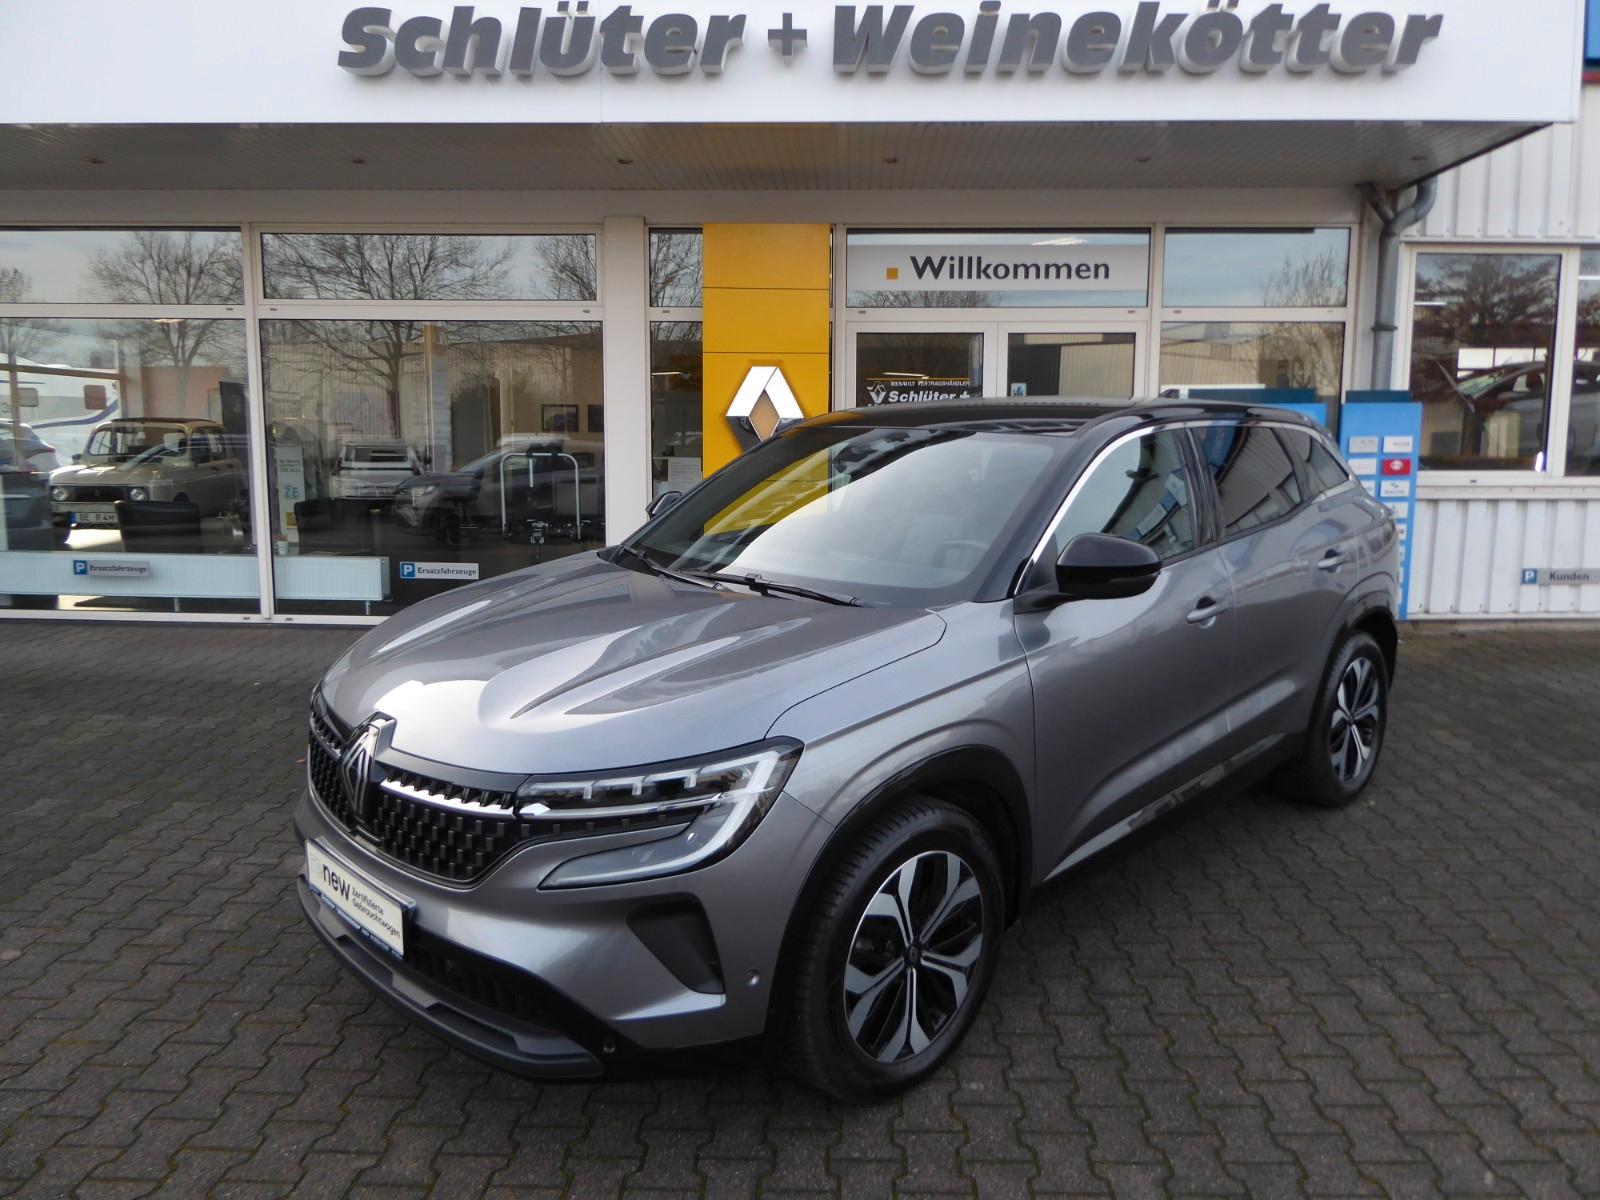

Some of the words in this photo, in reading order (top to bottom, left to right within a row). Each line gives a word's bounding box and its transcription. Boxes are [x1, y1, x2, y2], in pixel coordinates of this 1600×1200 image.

[337, 0, 747, 76] Schlüter
[767, 12, 807, 62] +
[833, 0, 1443, 76] Weinekötter
[910, 256, 1110, 280] Willkommen
[888, 390, 957, 402] Schlüter
[89, 564, 147, 574] Ersatzfahrzeuge
[417, 567, 477, 576] Ersatzfahrzeuge
[1549, 571, 1590, 581] Kunden
[322, 863, 351, 901] new
[351, 886, 384, 916] Zertifizierte
[352, 897, 401, 938] Gebrauchtwagen
